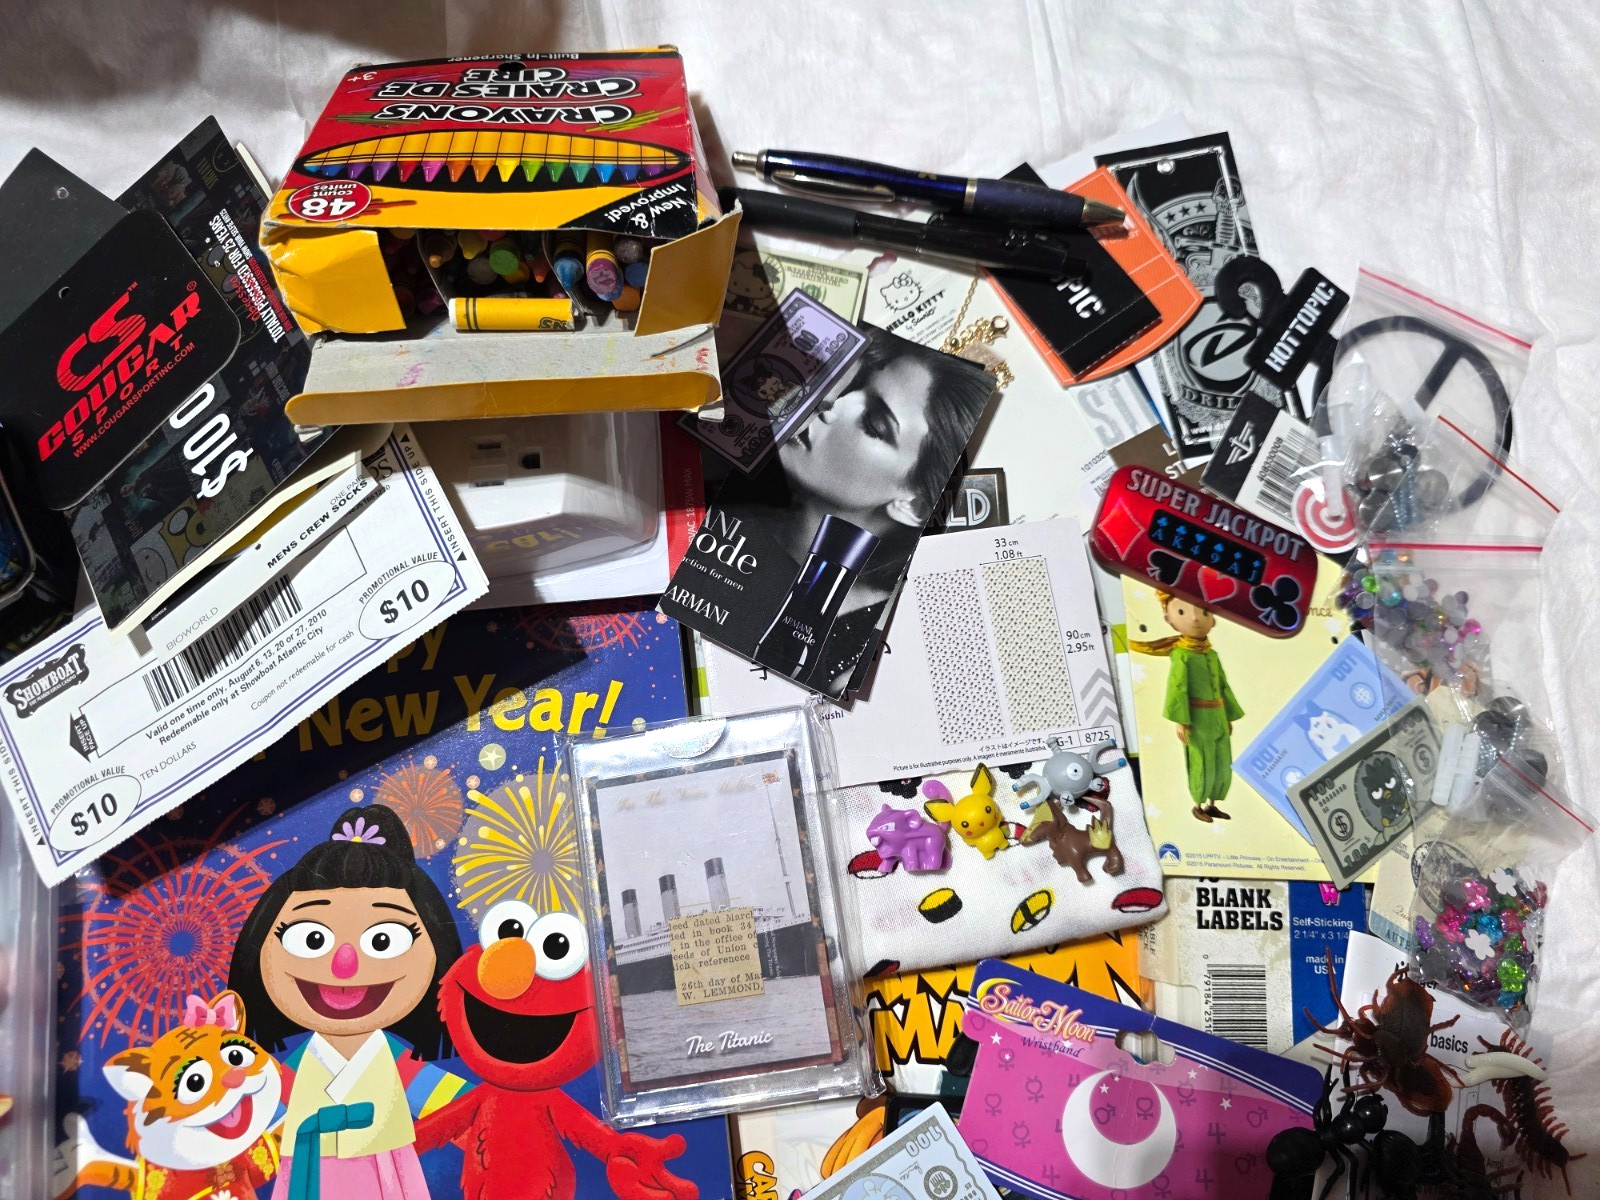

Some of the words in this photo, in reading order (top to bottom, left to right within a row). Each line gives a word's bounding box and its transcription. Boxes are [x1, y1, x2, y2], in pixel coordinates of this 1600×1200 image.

[447, 54, 522, 63] Sharpener
[526, 53, 580, 61] Built-In
[346, 72, 375, 82] 3+
[464, 67, 567, 83] CIRE
[378, 80, 451, 97] DE
[451, 77, 637, 99] CRAIES
[375, 104, 633, 125] CRAYONS
[317, 189, 352, 198] count
[606, 183, 687, 223] Improved!
[301, 196, 351, 216] 48
[652, 196, 686, 219] New
[207, 214, 232, 244] YEARS
[627, 213, 650, 231] &
[221, 239, 237, 253] 25
[226, 248, 246, 269] FOR
[886, 310, 915, 332] HELLO
[914, 289, 945, 314] KITTY
[258, 306, 288, 343] TOTALLY
[1262, 329, 1304, 374] HOT
[1286, 279, 1339, 339] TOPIC
[37, 292, 202, 462] COUGAR
[169, 383, 254, 499] $100
[404, 446, 415, 460] UP
[414, 460, 428, 486] SIDE
[330, 490, 346, 505] ONE
[346, 474, 364, 491] PAIR
[425, 488, 441, 513] THIS
[267, 540, 298, 569] MENS
[300, 513, 330, 540] CREW
[331, 480, 368, 513] SOCKS
[1127, 469, 1201, 517] SUPER
[1203, 504, 1305, 562] JACKPOT
[437, 516, 459, 553] INSERT
[995, 538, 1007, 549] 33
[696, 533, 758, 576] ode
[995, 549, 1015, 561] 1.08
[1016, 550, 1023, 558] ft
[359, 558, 409, 604] PROMOTIONAL
[411, 552, 438, 566] VALUE
[709, 568, 723, 580] for
[724, 576, 744, 591] men
[379, 579, 429, 625] $10
[664, 584, 731, 626] ARMANI
[166, 606, 219, 650] BIOWORLD
[782, 614, 814, 637] ARMANI
[1066, 629, 1080, 641] 90
[1080, 631, 1091, 639] cm
[793, 630, 816, 646] code
[1066, 642, 1088, 654] 2.95
[13, 649, 82, 712] SHOWBOAT
[144, 721, 169, 741] Valid
[168, 712, 186, 726] one
[184, 697, 207, 715] time
[225, 664, 258, 689] August
[273, 639, 287, 652] 20
[293, 623, 309, 637] 27,
[306, 608, 329, 627] 2010
[248, 688, 279, 712] Coupon
[274, 679, 289, 693] not
[285, 650, 330, 684] redeemable
[324, 641, 337, 653] for
[334, 628, 355, 646] cash
[156, 708, 213, 746] Redeemable
[209, 695, 231, 714] only
[237, 661, 281, 693] Showboat
[274, 637, 309, 664] Atlantic
[306, 625, 326, 642] City
[299, 690, 440, 752] New
[454, 673, 623, 739] Year!
[78, 719, 88, 730] UP
[75, 723, 89, 752] INSERT
[82, 730, 96, 751] FACE
[1085, 730, 1111, 743] 8725
[139, 766, 160, 782] TEN
[159, 741, 197, 773] DOLLARS
[893, 764, 909, 772] Picture
[942, 757, 962, 767] purposes
[999, 748, 1024, 757] meramente
[8, 767, 26, 796] THIS
[50, 772, 99, 816] PROMOTIONAL
[101, 765, 126, 779] VALUE
[21, 798, 41, 838] INSERT
[70, 792, 118, 837] $10
[1344, 843, 1370, 867] 100
[1196, 887, 1272, 908] BLANK
[692, 928, 702, 938] in
[709, 923, 733, 935] book
[740, 922, 752, 931] 34
[693, 915, 720, 928] dated
[1196, 909, 1283, 931] LABELS
[1292, 916, 1353, 930] Self-Sticking
[680, 940, 690, 950] in
[694, 937, 711, 948] the
[715, 933, 744, 945] office
[1294, 930, 1301, 939] 2
[1302, 930, 1319, 939] 1/4"
[1328, 931, 1334, 940] 3
[717, 943, 747, 954] Union
[1305, 954, 1330, 964] made
[1334, 953, 1344, 964] in
[1314, 964, 1336, 975] USA
[681, 981, 704, 991] 26th
[708, 977, 726, 988] day
[730, 974, 741, 983] of
[1203, 973, 1212, 1006] 79184
[682, 991, 696, 1001] W.
[980, 983, 1037, 1024] Sailor
[1037, 998, 1097, 1043] Moon
[685, 1035, 716, 1056] The
[718, 1030, 774, 1050] Titanic
[1022, 1036, 1085, 1058] Wristband
[1430, 1033, 1469, 1054] basics
[904, 1124, 943, 1157] 100
